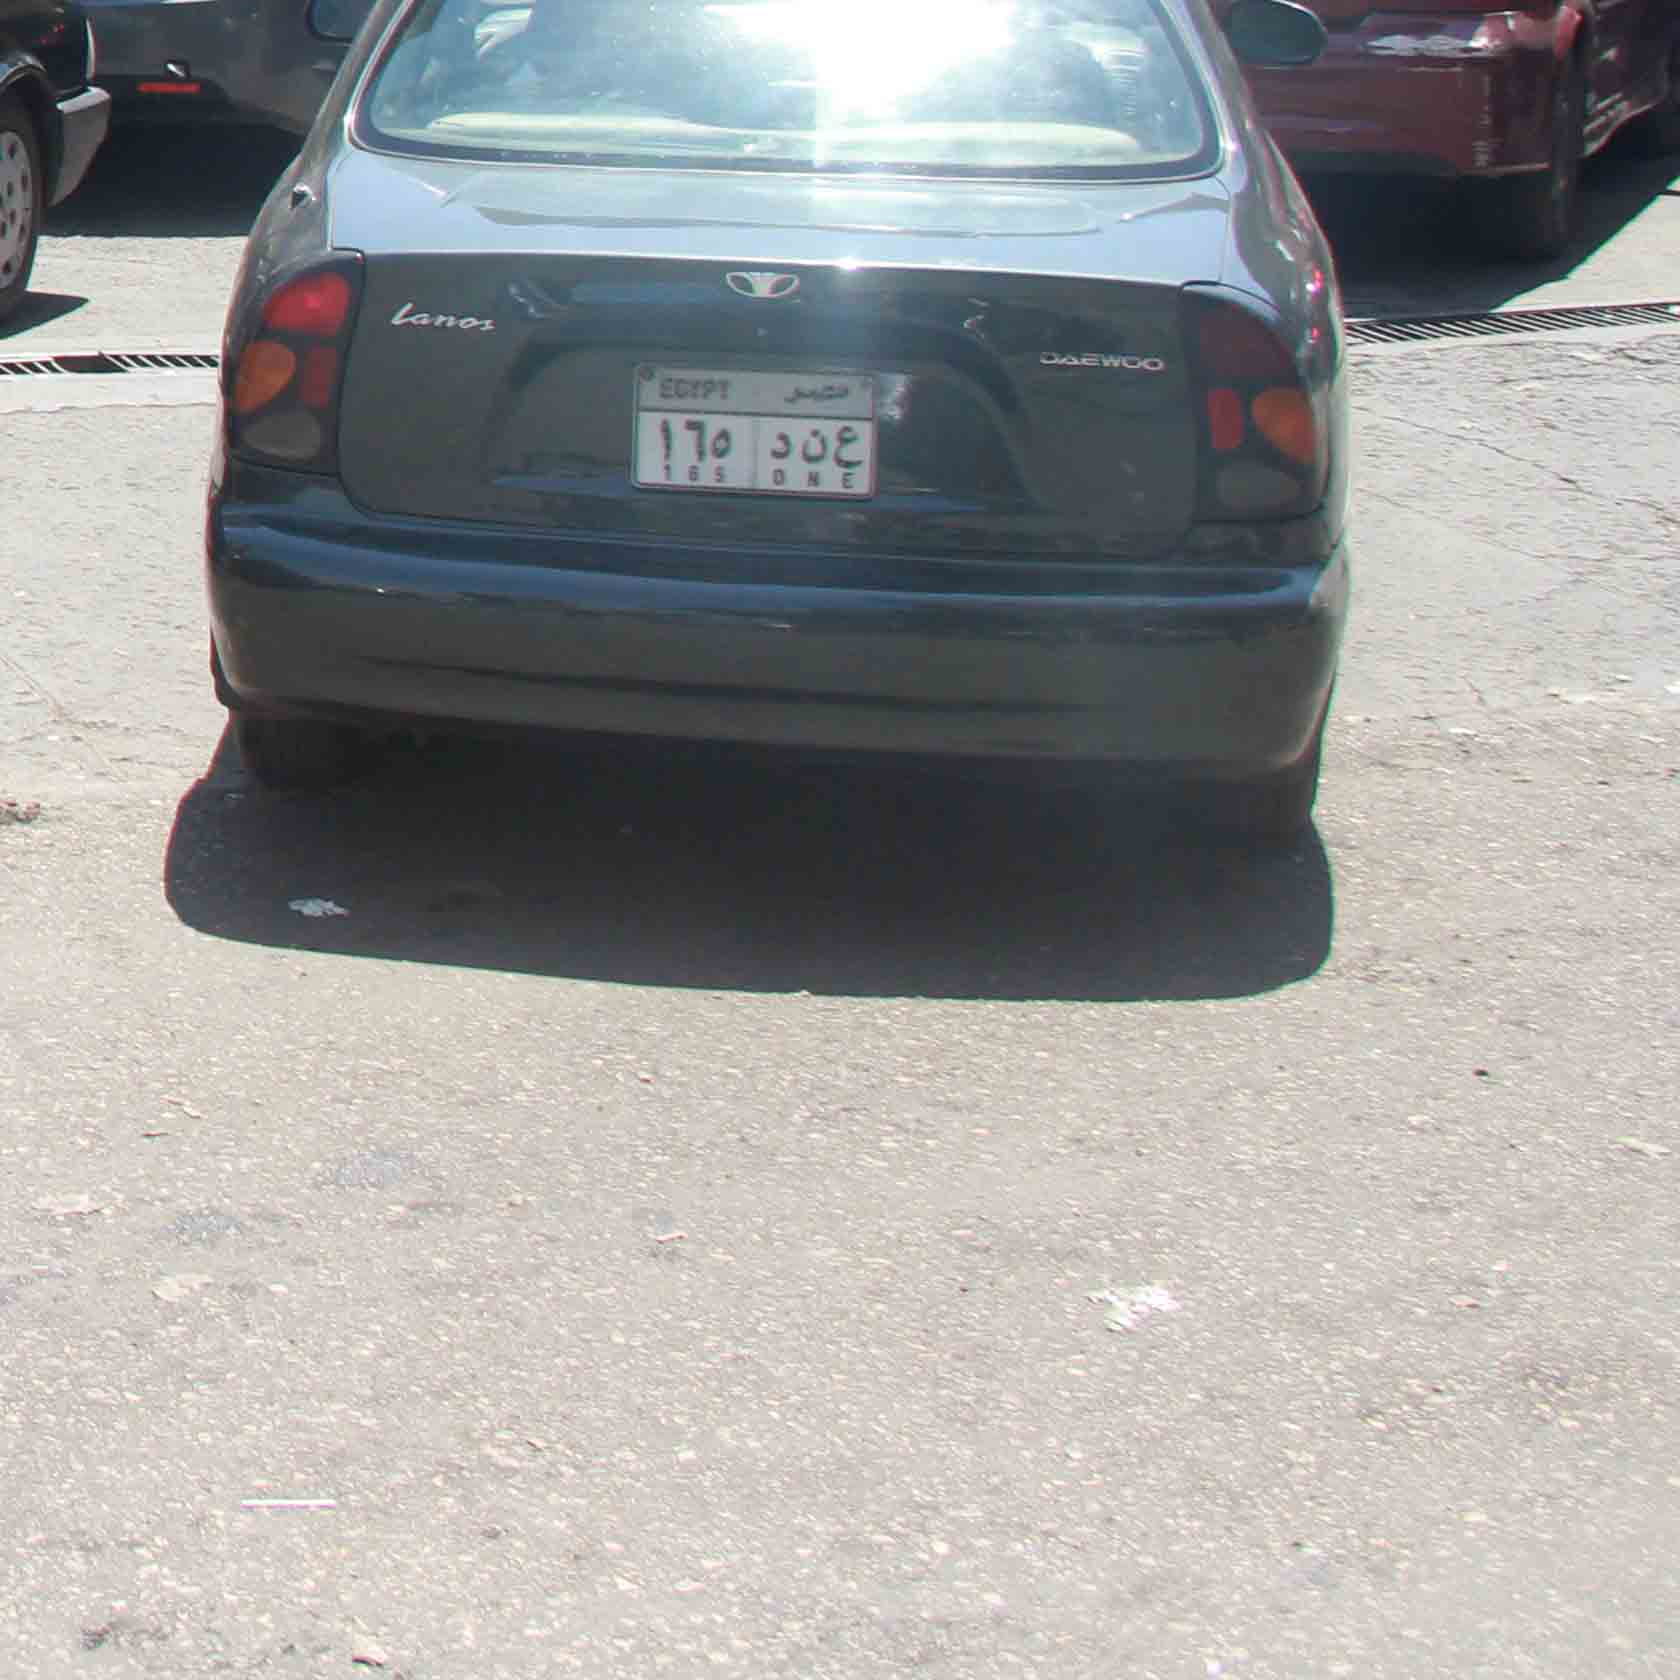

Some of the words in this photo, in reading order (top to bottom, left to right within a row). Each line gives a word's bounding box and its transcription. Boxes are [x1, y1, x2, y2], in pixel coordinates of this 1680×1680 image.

[391, 301, 497, 331] Lanos
[1040, 351, 1165, 371] DAEWOO
[658, 376, 730, 401] EGYPT
